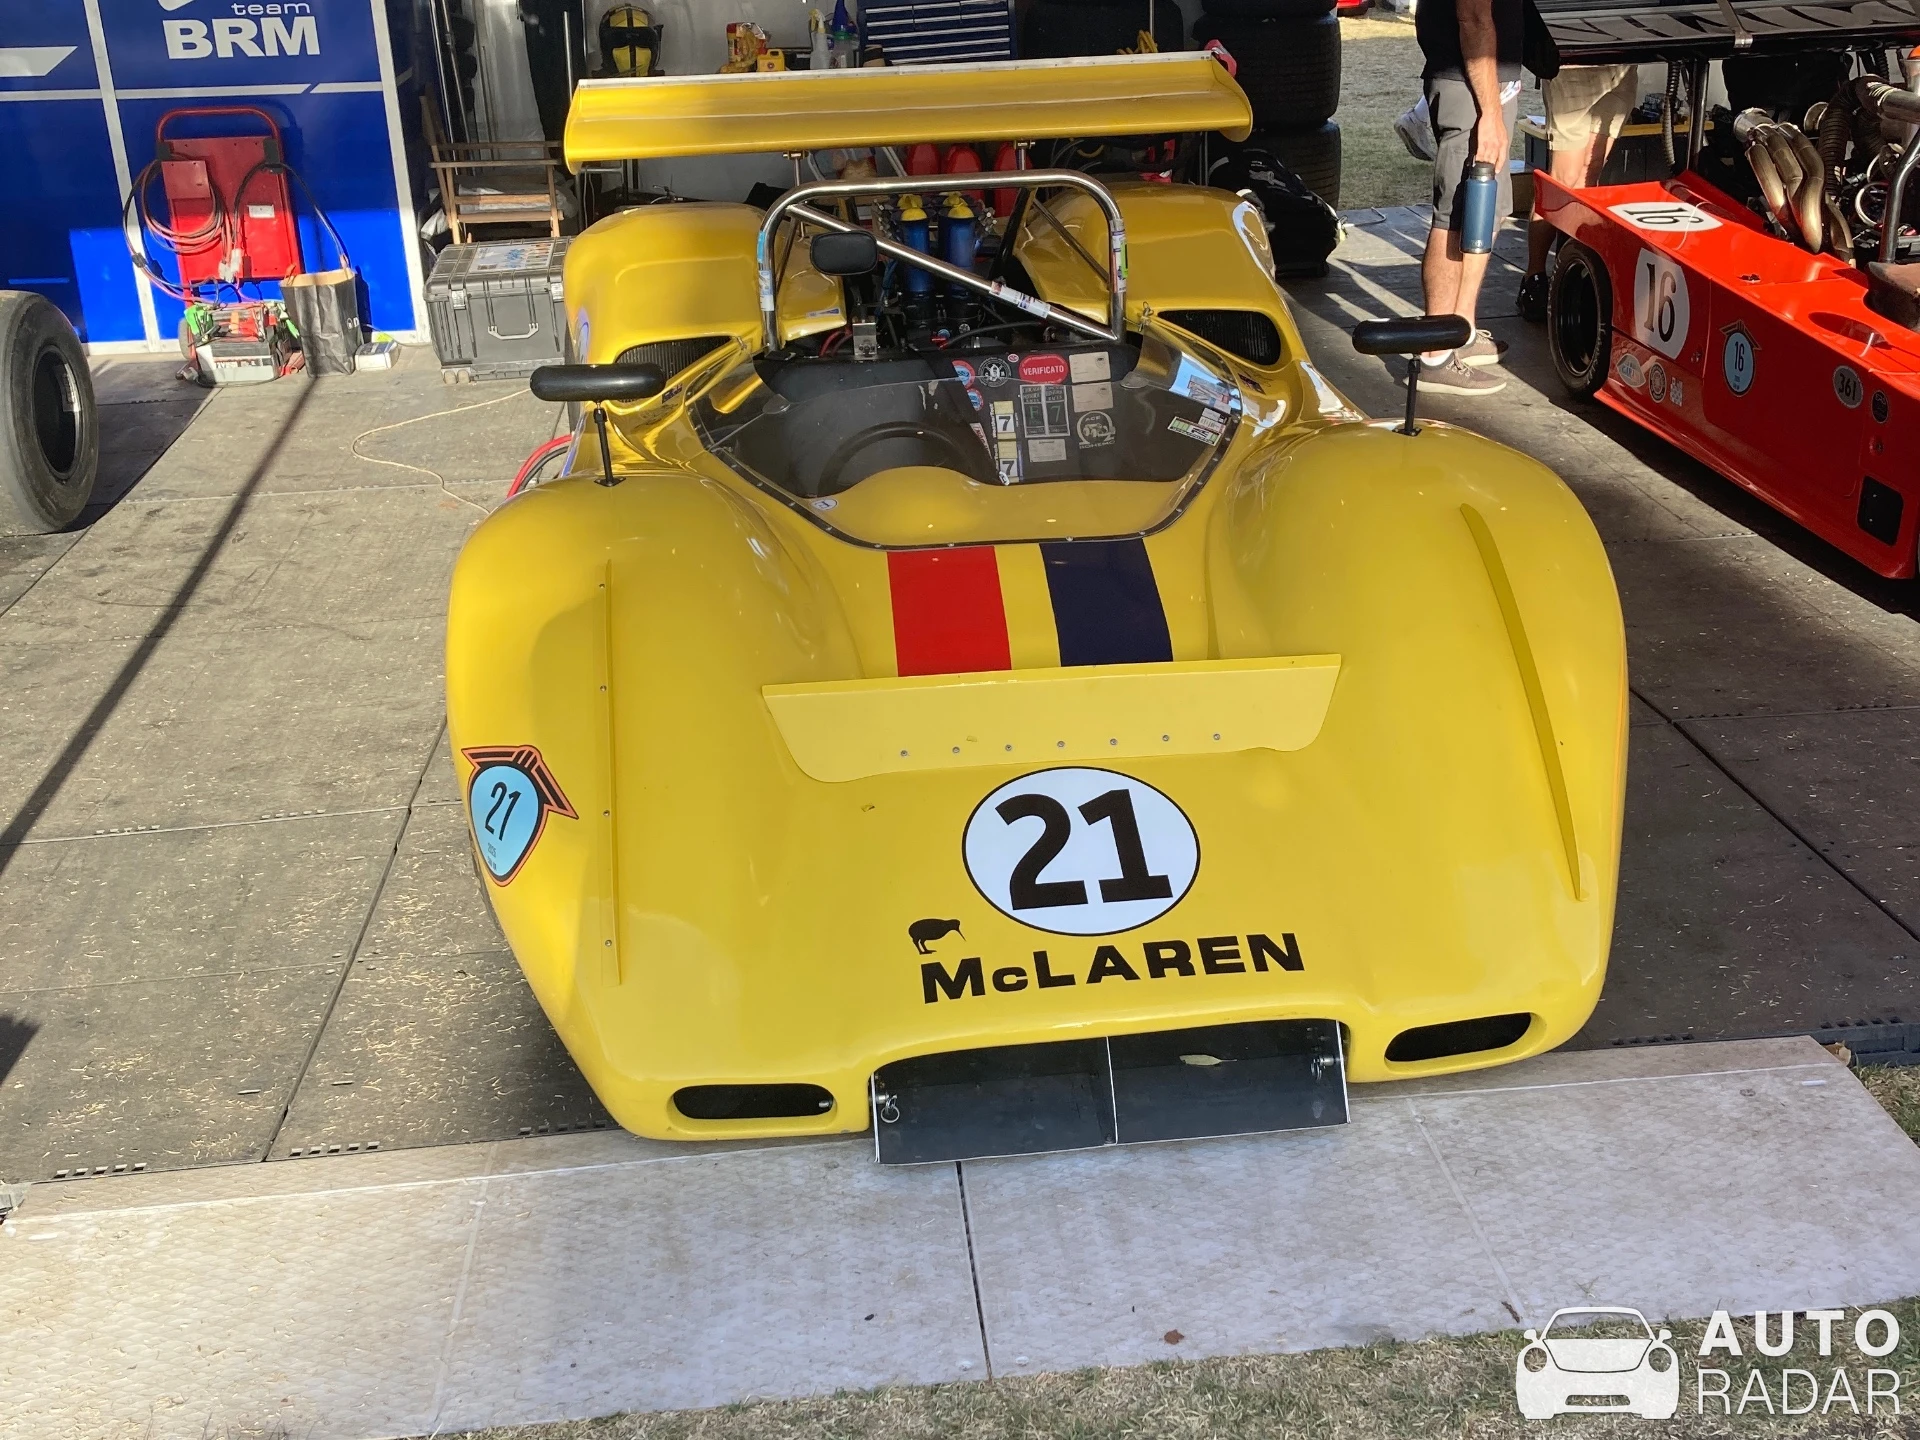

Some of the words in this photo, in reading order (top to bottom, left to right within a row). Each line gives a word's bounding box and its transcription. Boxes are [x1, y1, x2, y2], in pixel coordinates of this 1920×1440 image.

[231, 3, 311, 16] team
[163, 15, 321, 59] BRM
[1623, 207, 1704, 225] 16
[1643, 262, 1677, 343] 16
[1022, 365, 1065, 376] VERIFICATO
[1733, 341, 1746, 372] 16
[1838, 372, 1857, 401] 361
[998, 415, 1011, 432] 7
[1002, 460, 1015, 476] 7
[485, 781, 522, 841] 21
[995, 789, 1173, 910] 21
[920, 932, 1305, 1004] McLAREN
